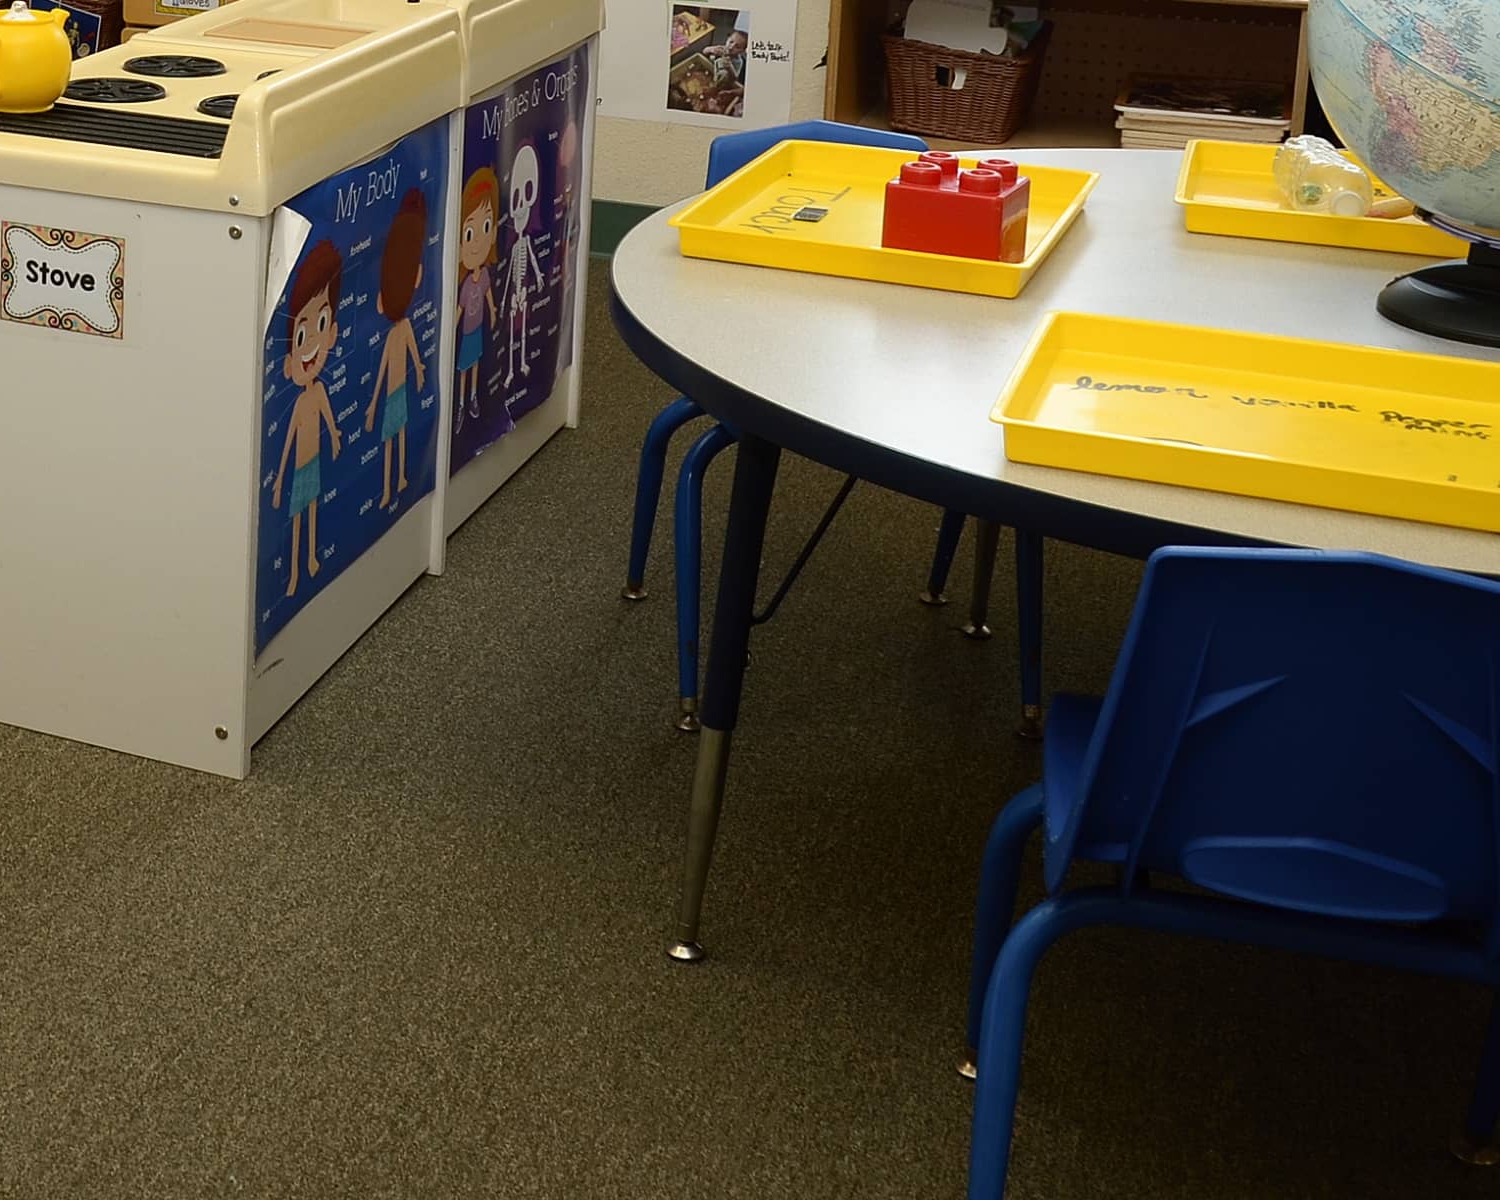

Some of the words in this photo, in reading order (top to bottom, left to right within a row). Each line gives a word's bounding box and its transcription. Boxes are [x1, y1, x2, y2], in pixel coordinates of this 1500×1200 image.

[482, 104, 504, 141] My
[531, 78, 541, 107] &
[335, 182, 362, 223] My
[366, 158, 401, 206] Body
[26, 260, 96, 292] Stove
